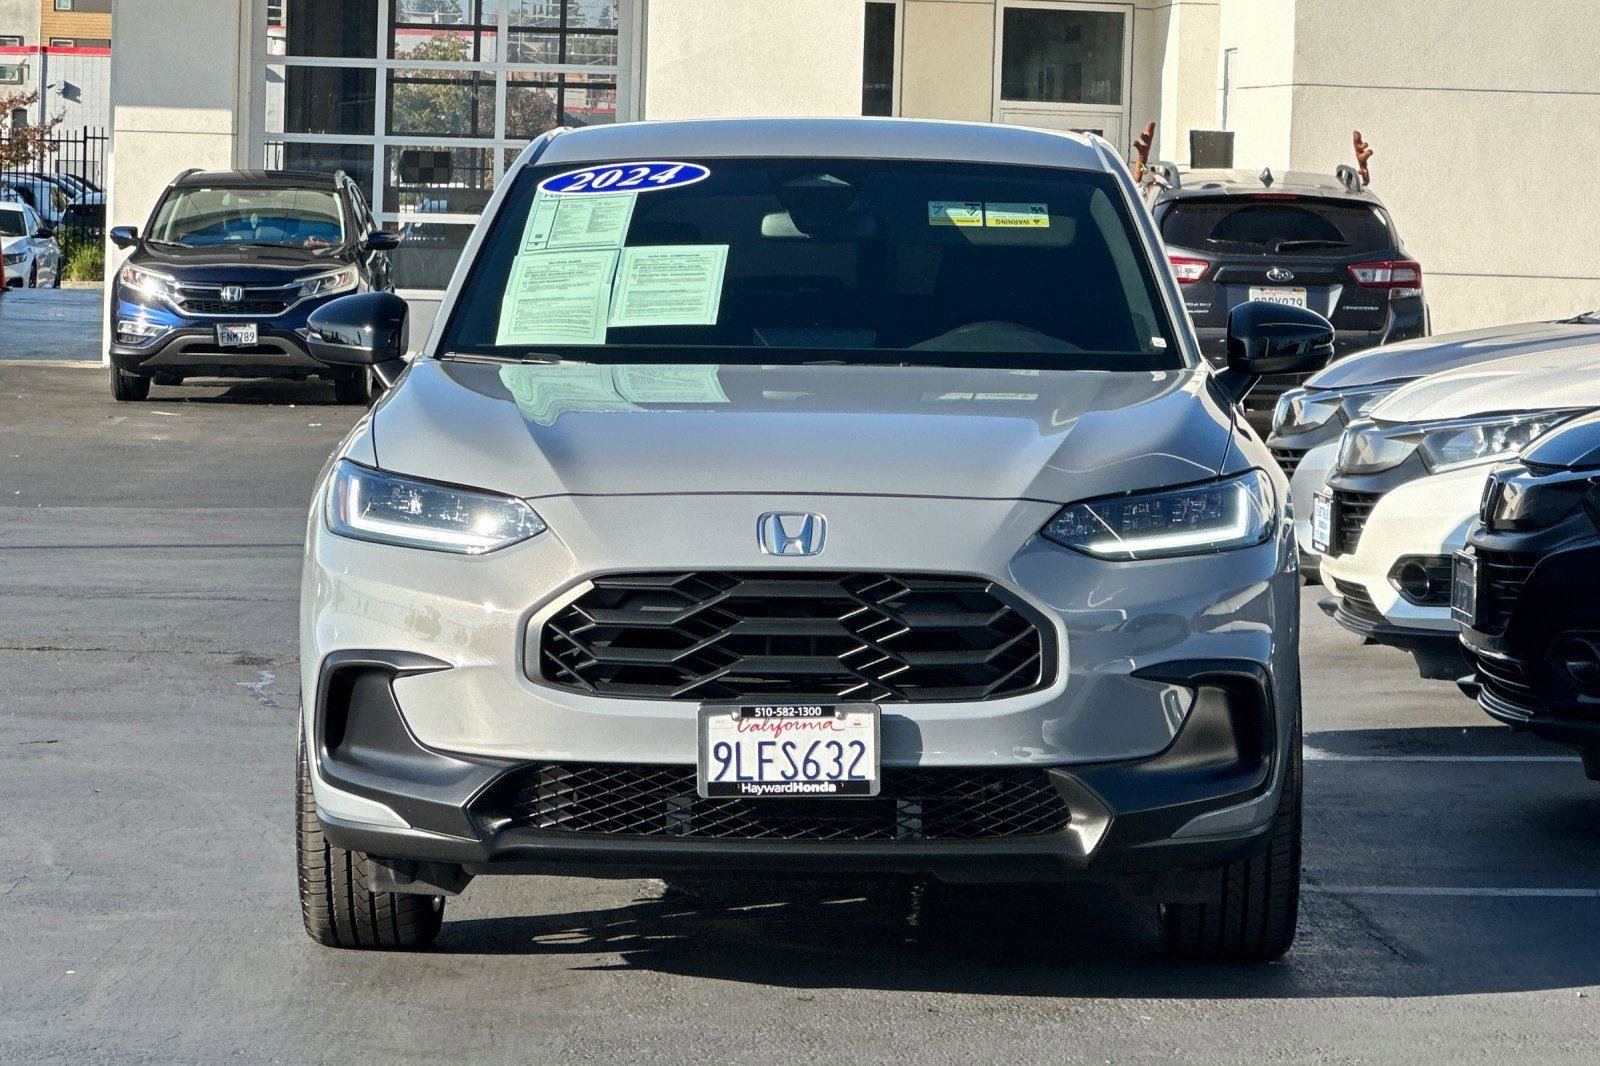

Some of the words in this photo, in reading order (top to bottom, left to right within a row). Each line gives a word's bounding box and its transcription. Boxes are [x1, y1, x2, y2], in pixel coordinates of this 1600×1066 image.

[561, 165, 685, 192] 2024
[754, 706, 822, 717] 510-582-1300
[737, 716, 845, 738] California
[713, 739, 866, 781] 9LFS632
